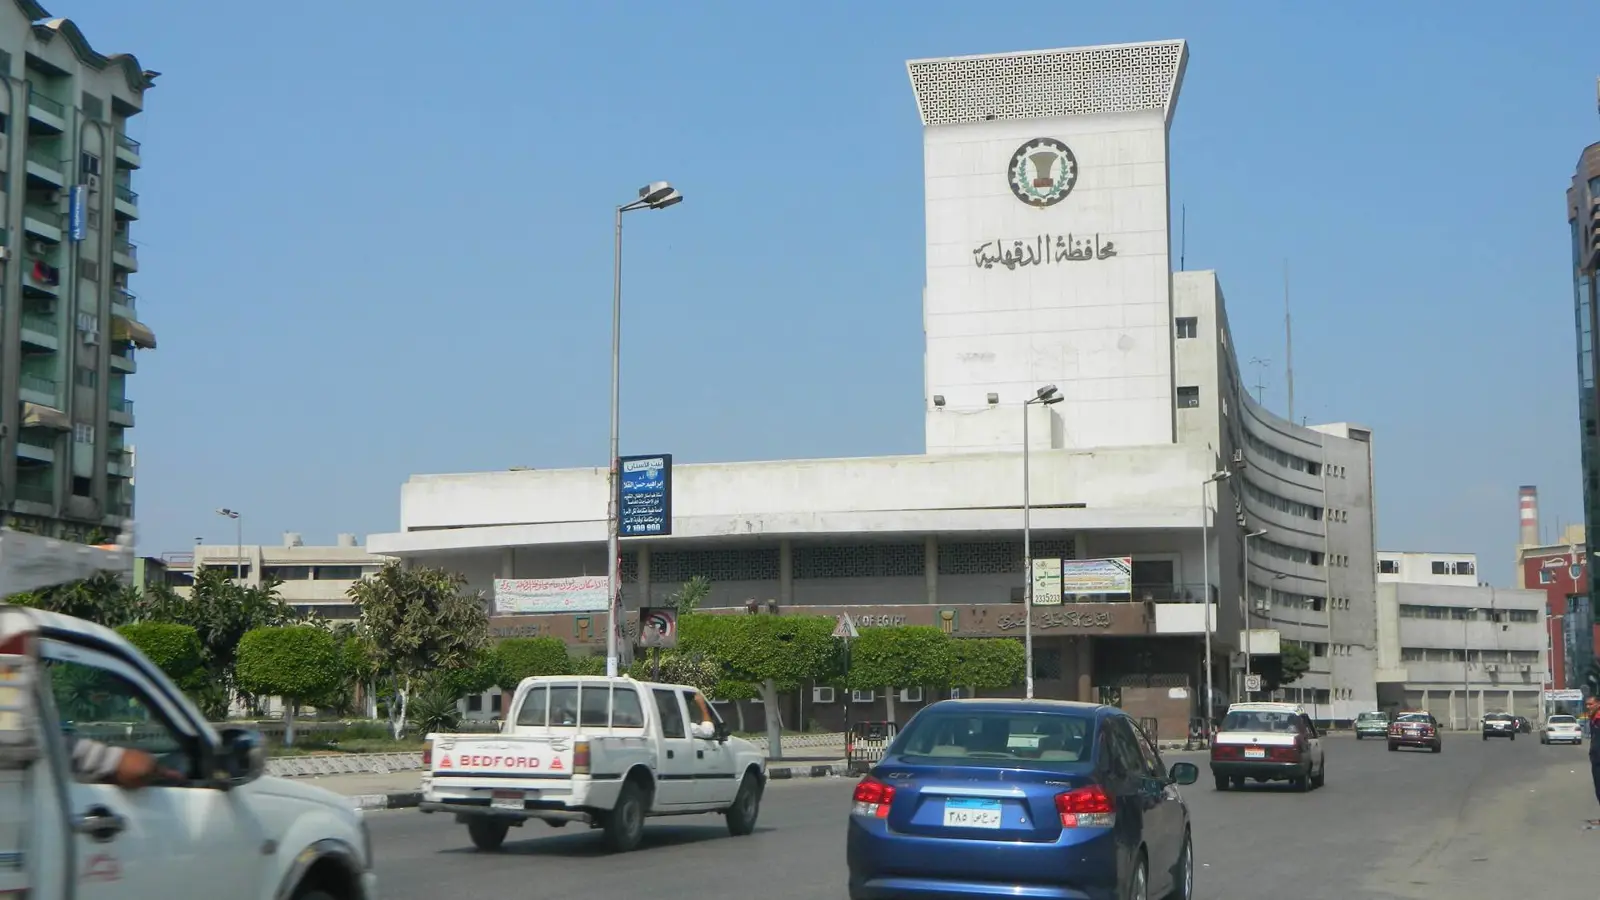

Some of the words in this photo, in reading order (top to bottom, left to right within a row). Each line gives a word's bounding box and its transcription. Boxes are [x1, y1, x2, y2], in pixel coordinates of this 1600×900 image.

[972, 234, 1051, 270] الدقهلية
[1055, 233, 1118, 264] محافظة
[1035, 593, 1060, 603] 2335233
[862, 615, 875, 627] OF
[878, 614, 907, 627] EGYPT
[460, 755, 540, 768] BEDFORD
